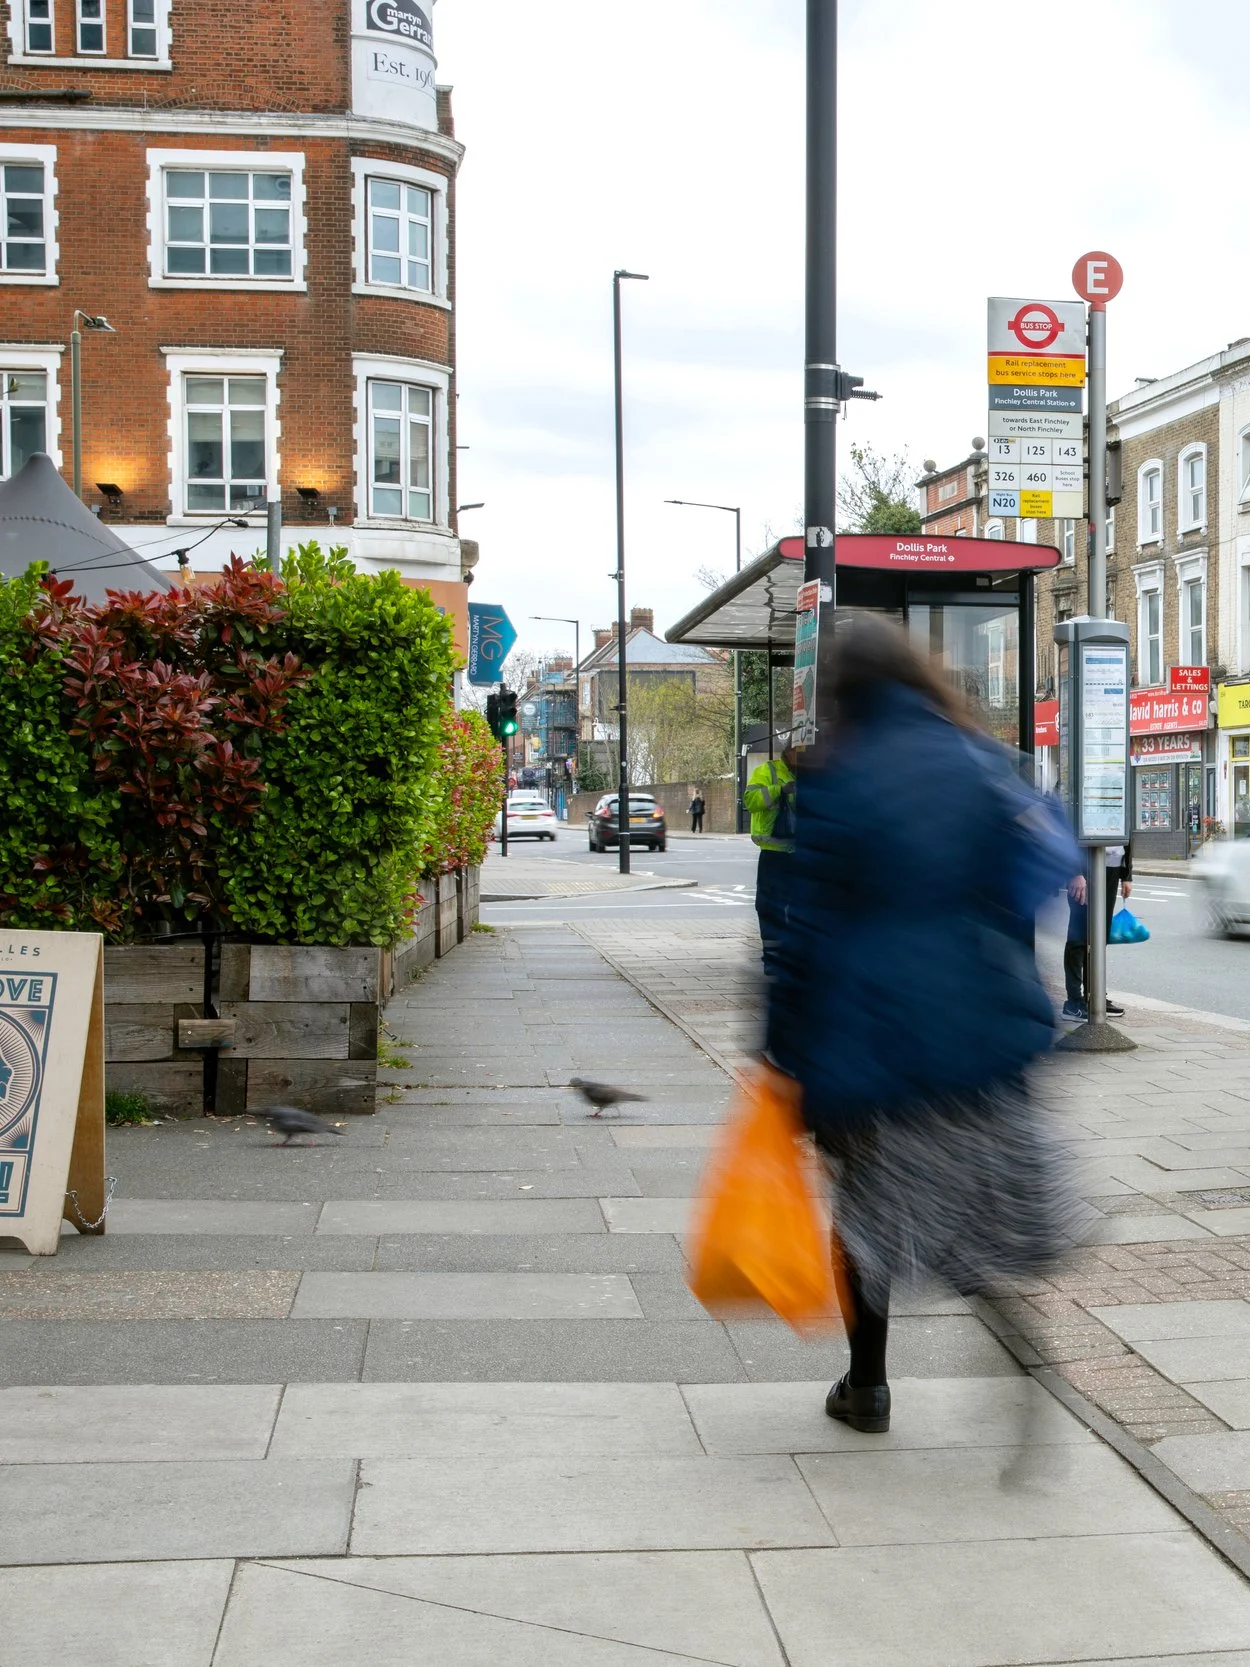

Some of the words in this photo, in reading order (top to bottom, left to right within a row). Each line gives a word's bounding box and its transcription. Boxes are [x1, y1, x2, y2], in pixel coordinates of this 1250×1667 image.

[387, 8, 422, 26] martyn
[370, 0, 432, 46] Gerrar
[373, 52, 410, 78] Est.
[415, 67, 433, 88] 196
[1087, 261, 1109, 294] E
[1013, 388, 1037, 397] Dollis
[1040, 389, 1058, 397] Park
[1044, 418, 1070, 426] Finchley
[1037, 426, 1064, 434] Finchley
[999, 445, 1011, 455] 13
[1027, 446, 1045, 455] 125
[1058, 447, 1077, 457] 143
[994, 471, 1015, 481] 326
[1027, 472, 1047, 482] 460
[993, 498, 1016, 508] N20
[896, 542, 925, 552] Dollis
[926, 543, 947, 553] Park
[889, 553, 919, 562] Finchley
[920, 554, 946, 562] Central
[472, 614, 480, 645] MARTYN
[480, 616, 504, 661] MG
[470, 645, 478, 676] GERRARD
[1178, 669, 1202, 677] SALES
[1172, 683, 1208, 691] LETTINGS
[1153, 699, 1178, 719] harris
[1182, 696, 1189, 716] &
[1192, 699, 1202, 715] co
[1142, 737, 1155, 753] 33
[1157, 734, 1190, 750] YEARS
[0, 944, 40, 957] LES
